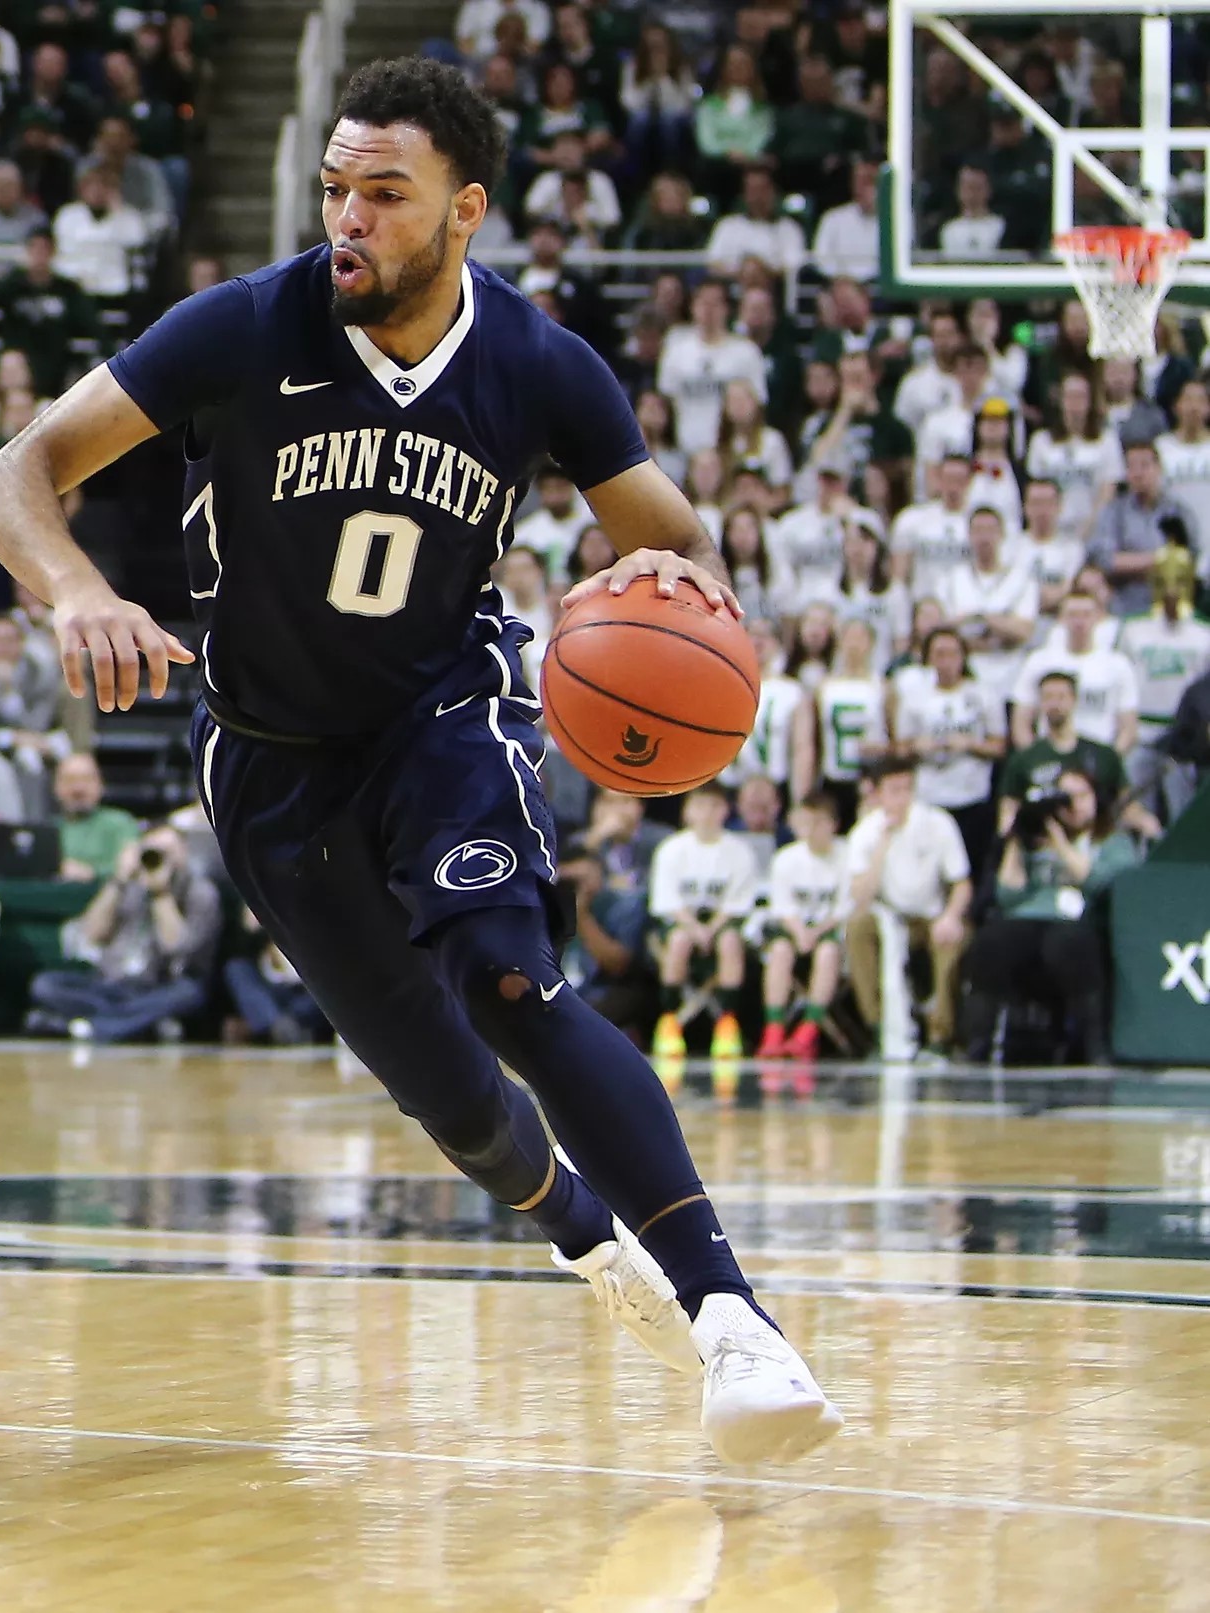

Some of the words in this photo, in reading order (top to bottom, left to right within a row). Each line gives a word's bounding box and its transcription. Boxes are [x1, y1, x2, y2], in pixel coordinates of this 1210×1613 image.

[272, 428, 386, 501] PENN
[389, 430, 499, 526] STATE
[327, 509, 424, 618] 0
[832, 703, 866, 769] E
